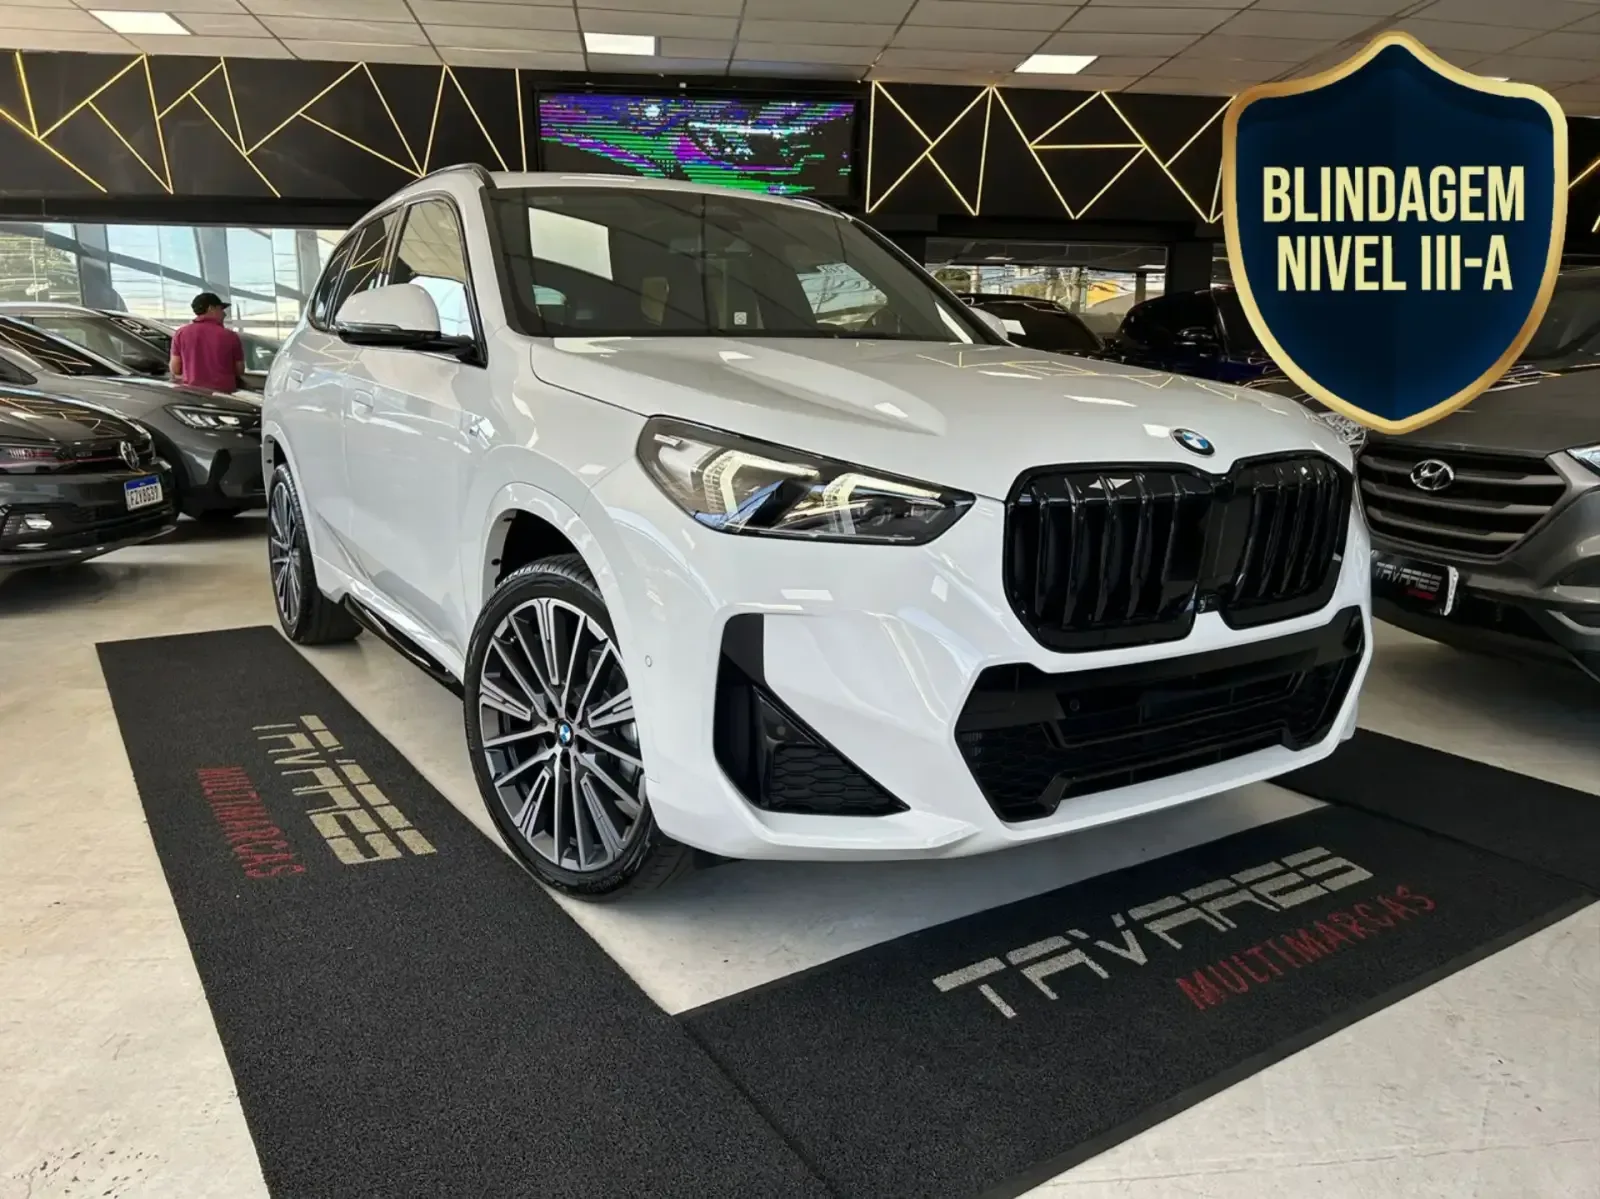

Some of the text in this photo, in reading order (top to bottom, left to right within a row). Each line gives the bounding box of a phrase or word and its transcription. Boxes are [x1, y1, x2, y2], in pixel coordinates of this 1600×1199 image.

[1376, 561, 1443, 592] TAVARES
[196, 766, 307, 879] MULTIMARCAS
[252, 714, 438, 865] TAVARES
[932, 846, 1374, 1019] TAVARES
[1175, 884, 1436, 1011] MULTIMARCAS
